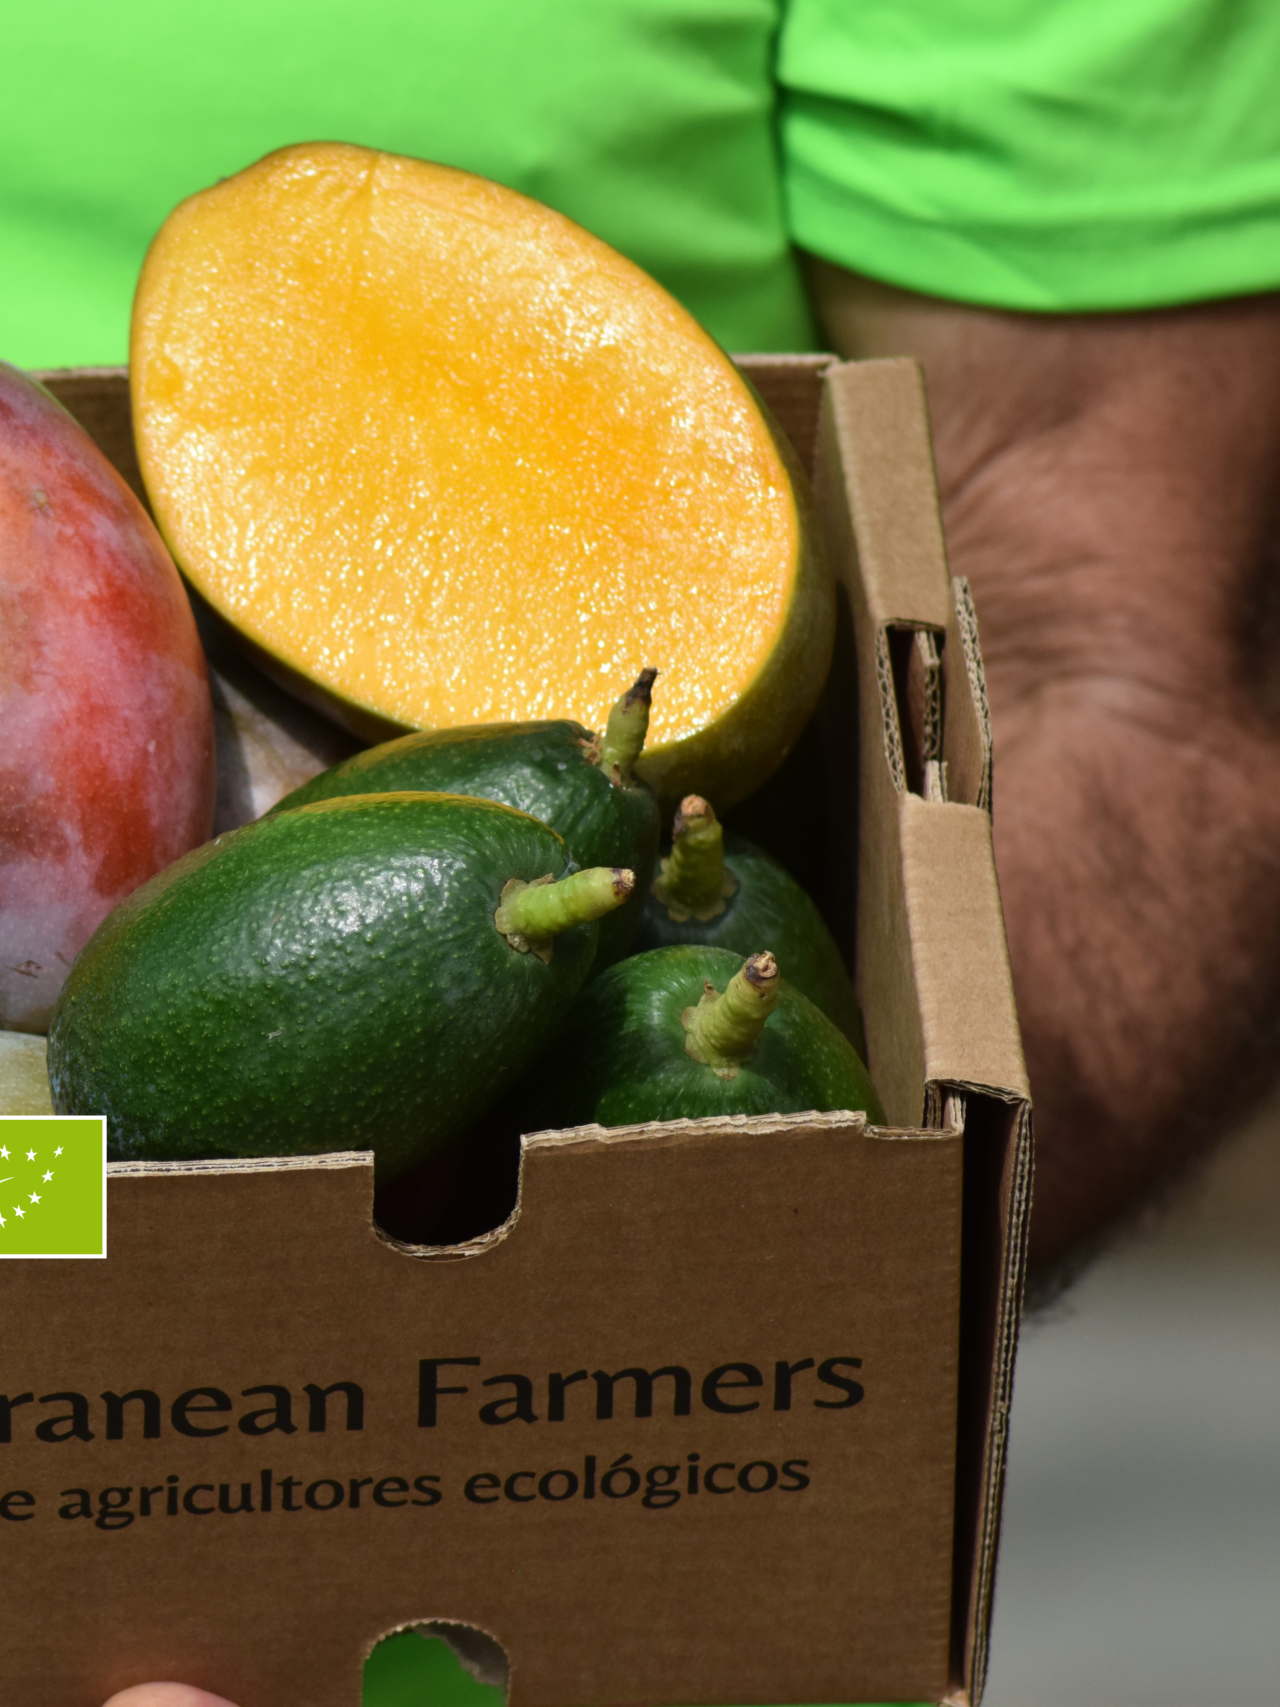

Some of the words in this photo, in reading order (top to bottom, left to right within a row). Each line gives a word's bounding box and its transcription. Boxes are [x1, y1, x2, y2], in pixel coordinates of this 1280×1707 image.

[417, 1356, 865, 1428] Farmers
[58, 1468, 442, 1531] agricultores
[463, 1452, 810, 1510] ecológicos
